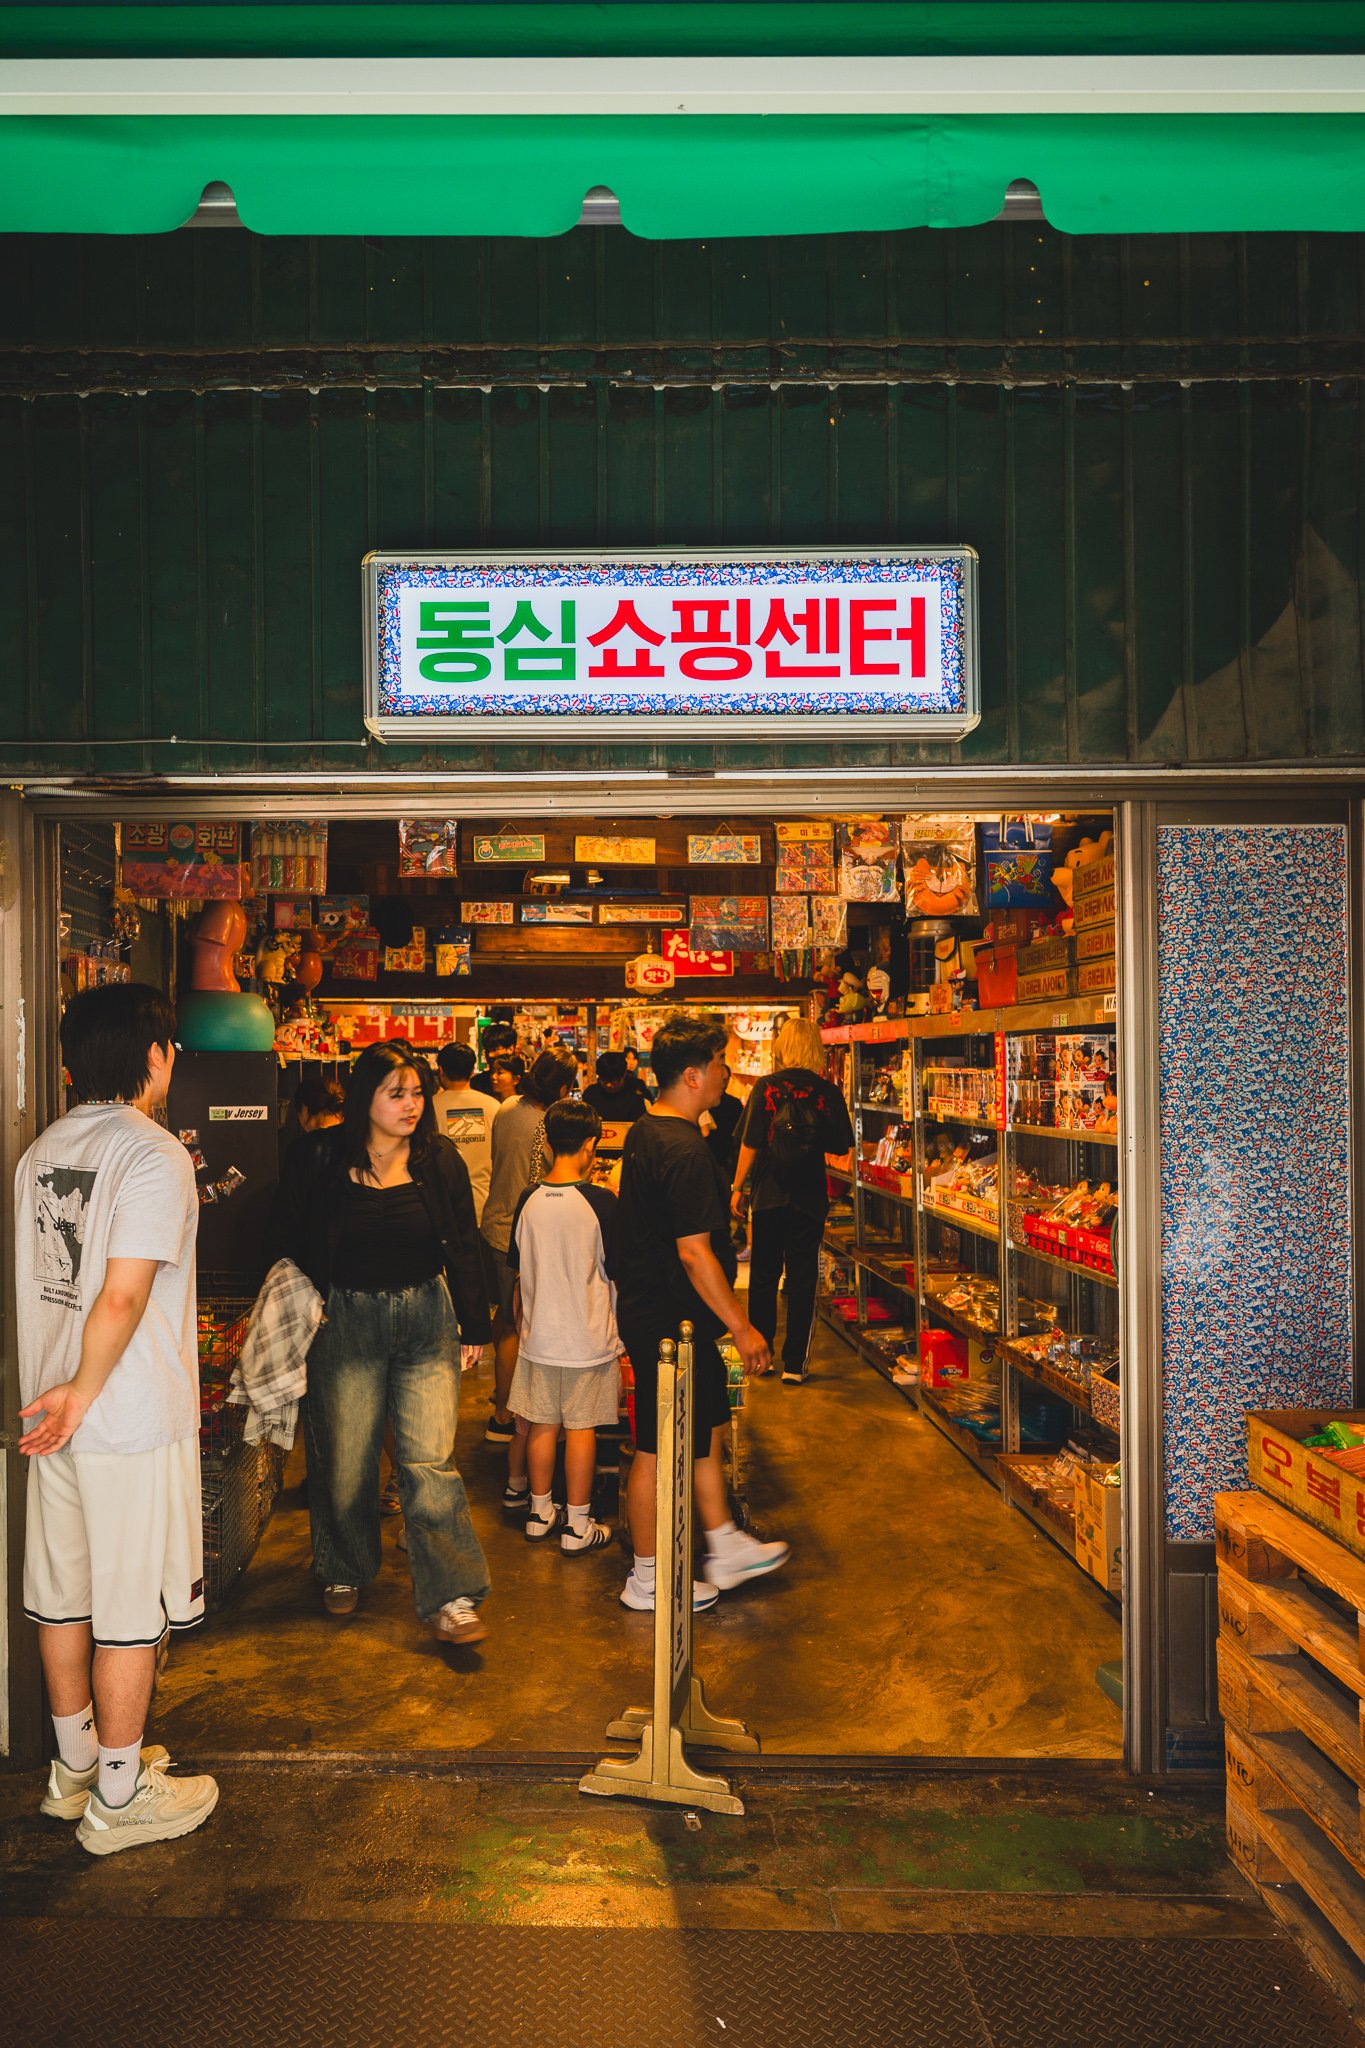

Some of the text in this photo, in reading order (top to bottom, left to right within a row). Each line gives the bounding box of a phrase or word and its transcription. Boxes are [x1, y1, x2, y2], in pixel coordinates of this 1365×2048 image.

[416, 597, 926, 682] 동심 쇼핑센터
[234, 1108, 264, 1119] Jersey
